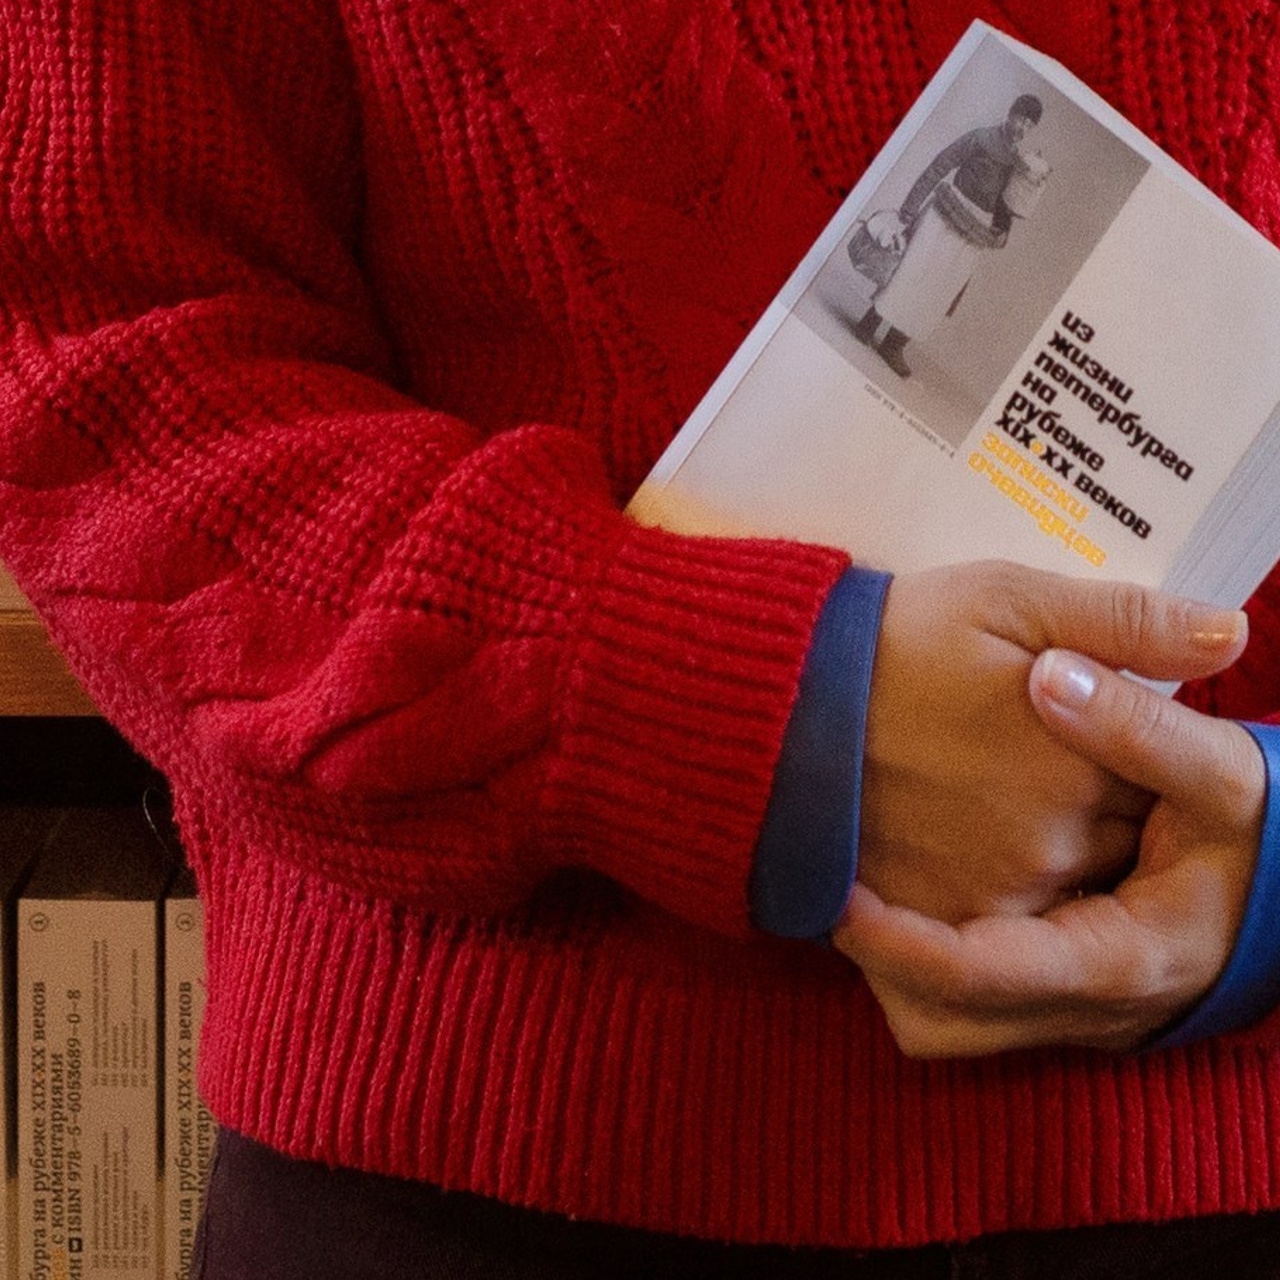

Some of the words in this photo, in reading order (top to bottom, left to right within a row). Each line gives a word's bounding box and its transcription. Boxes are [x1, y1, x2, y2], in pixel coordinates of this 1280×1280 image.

[1062, 311, 1095, 343] из
[1021, 370, 1058, 405] на
[1048, 330, 1134, 404] жизни
[1005, 391, 1105, 472] рубеже
[1034, 351, 1194, 481] петербурга
[981, 431, 1090, 523] записки
[1074, 472, 1152, 539] веков
[33, 981, 46, 1041] веков
[178, 981, 192, 1040] веков
[29, 1118, 49, 1192] рубеже
[51, 1052, 69, 1228] комментариями
[175, 1118, 196, 1192] рубеже
[33, 1198, 46, 1222] на
[68, 1188, 82, 1233] ISBN
[179, 1198, 192, 1221] на
